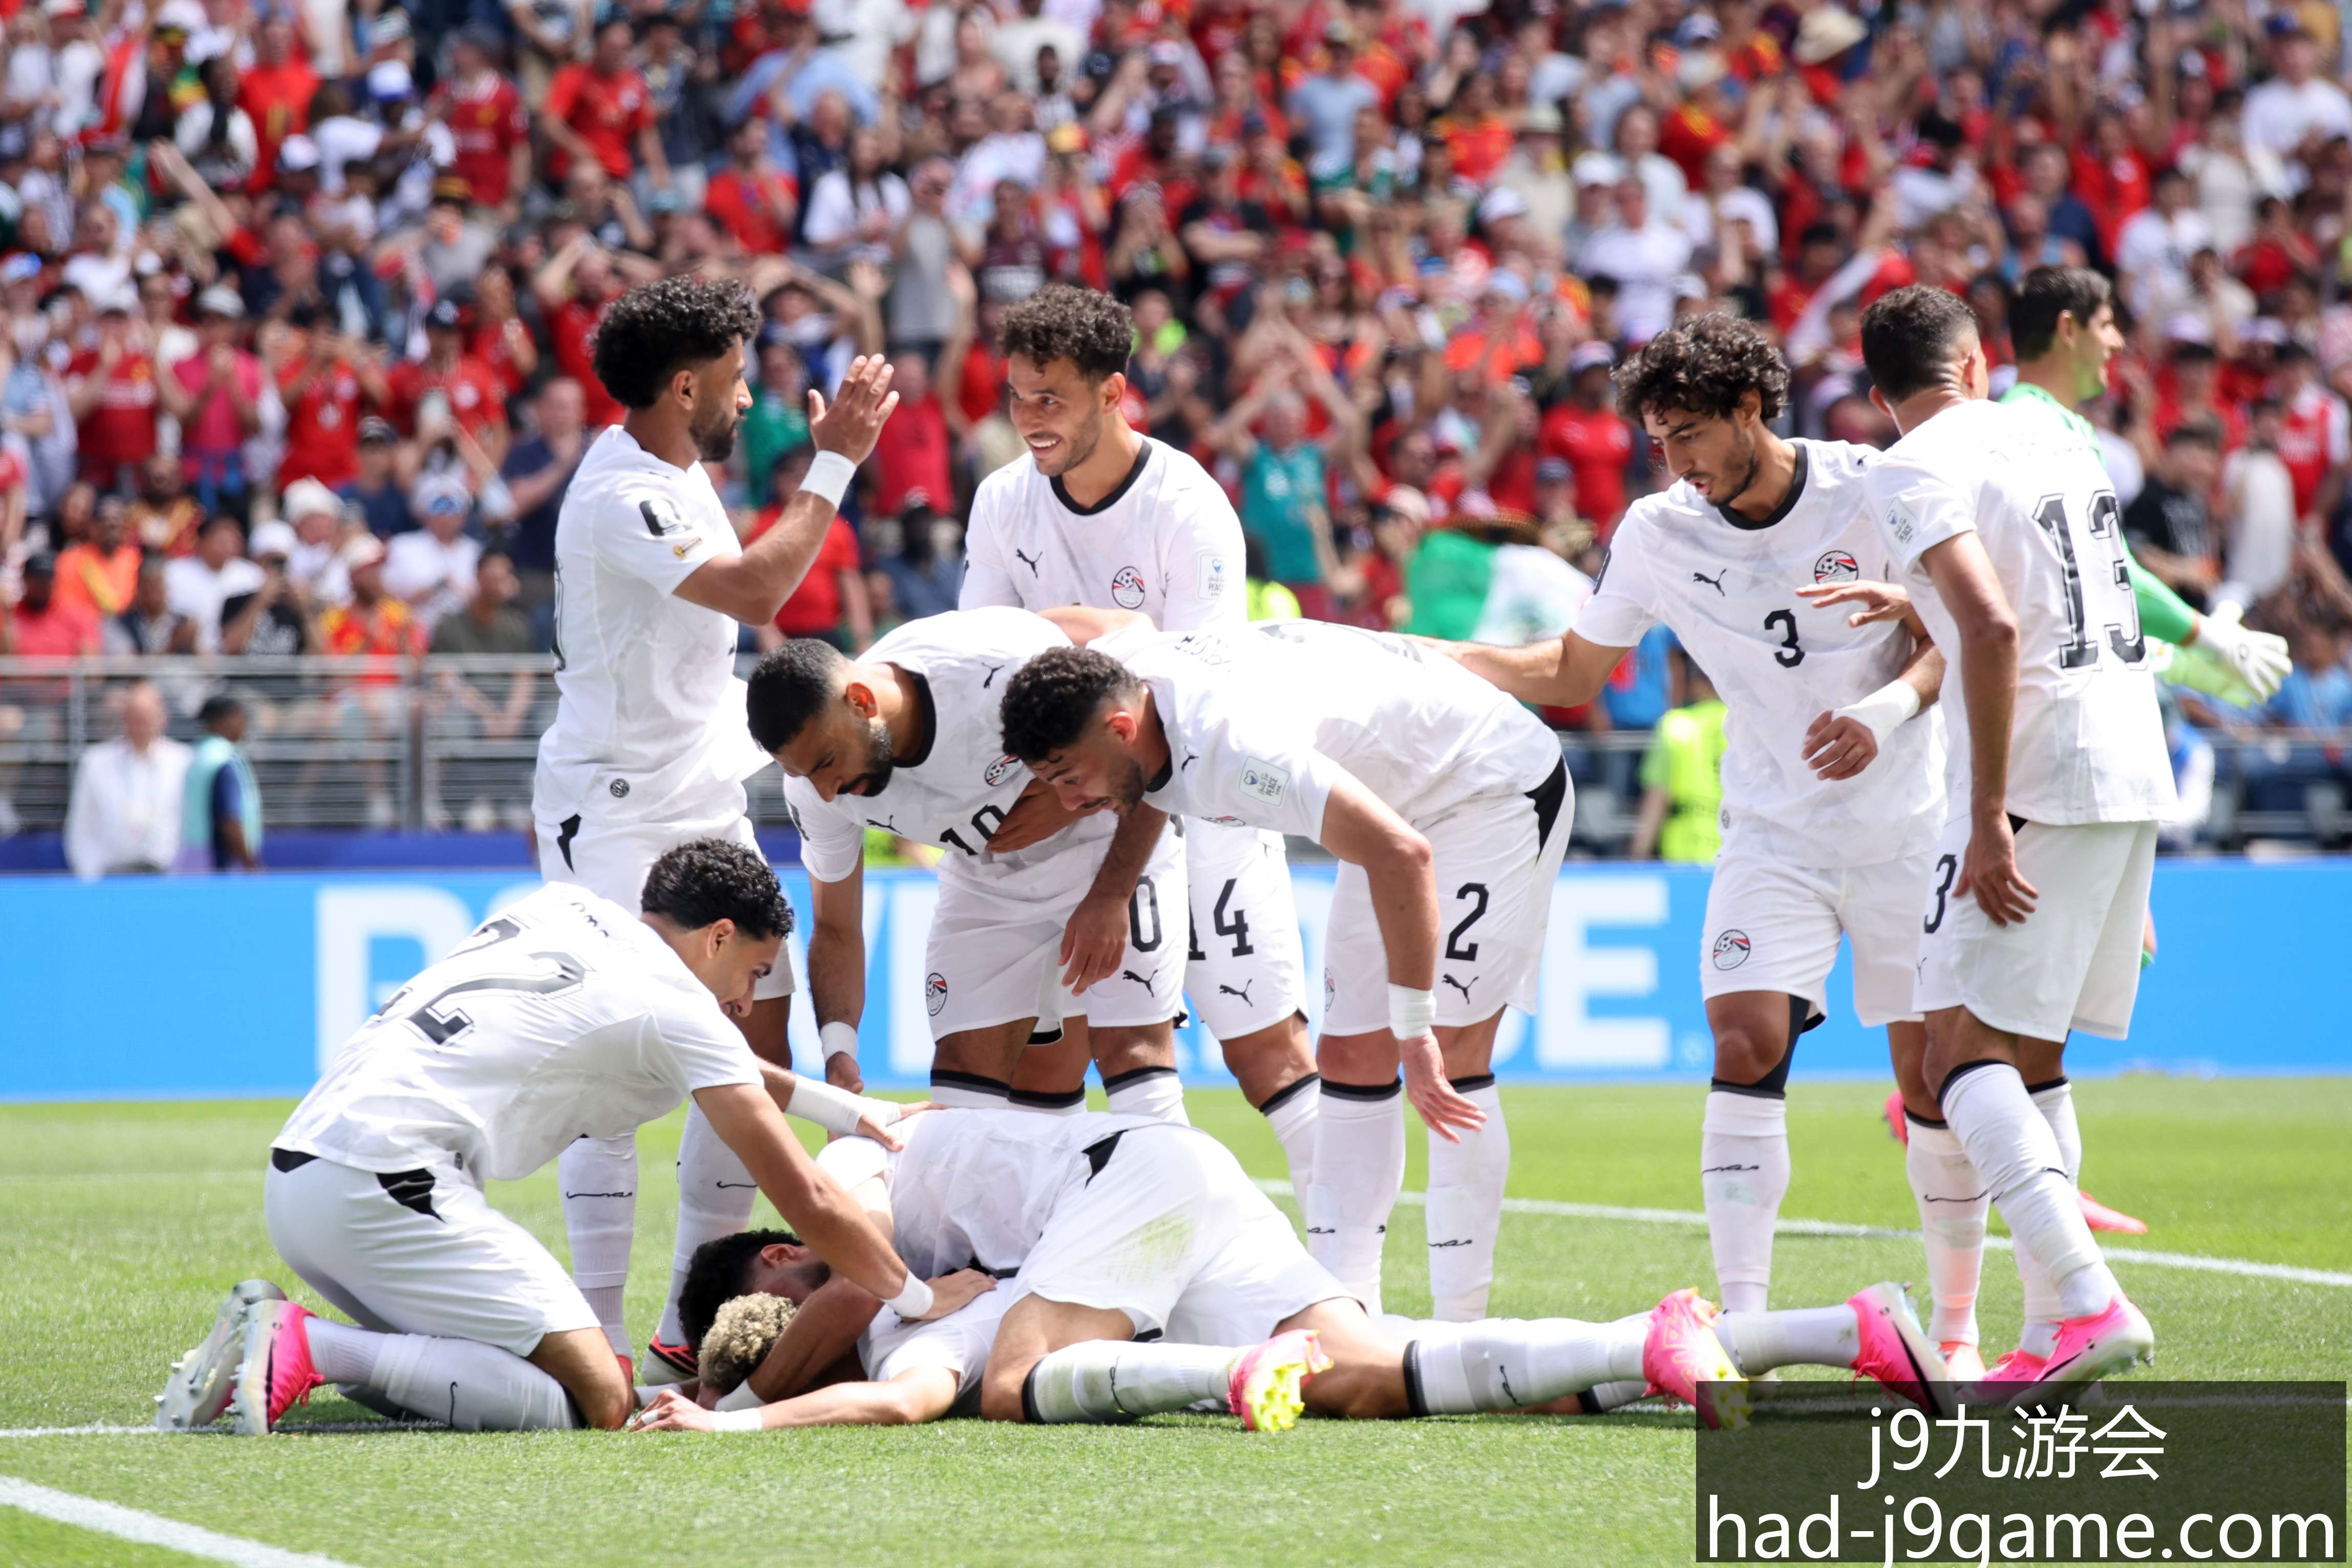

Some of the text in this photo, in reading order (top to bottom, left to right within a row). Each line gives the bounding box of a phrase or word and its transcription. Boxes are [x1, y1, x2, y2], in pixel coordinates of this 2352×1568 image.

[1209, 583, 1224, 592] PEAC
[2032, 489, 2150, 675] 13
[1764, 608, 1806, 668] 3
[1265, 776, 1279, 797] PEACE
[1445, 882, 1489, 961] 2
[1924, 854, 1957, 934] 3
